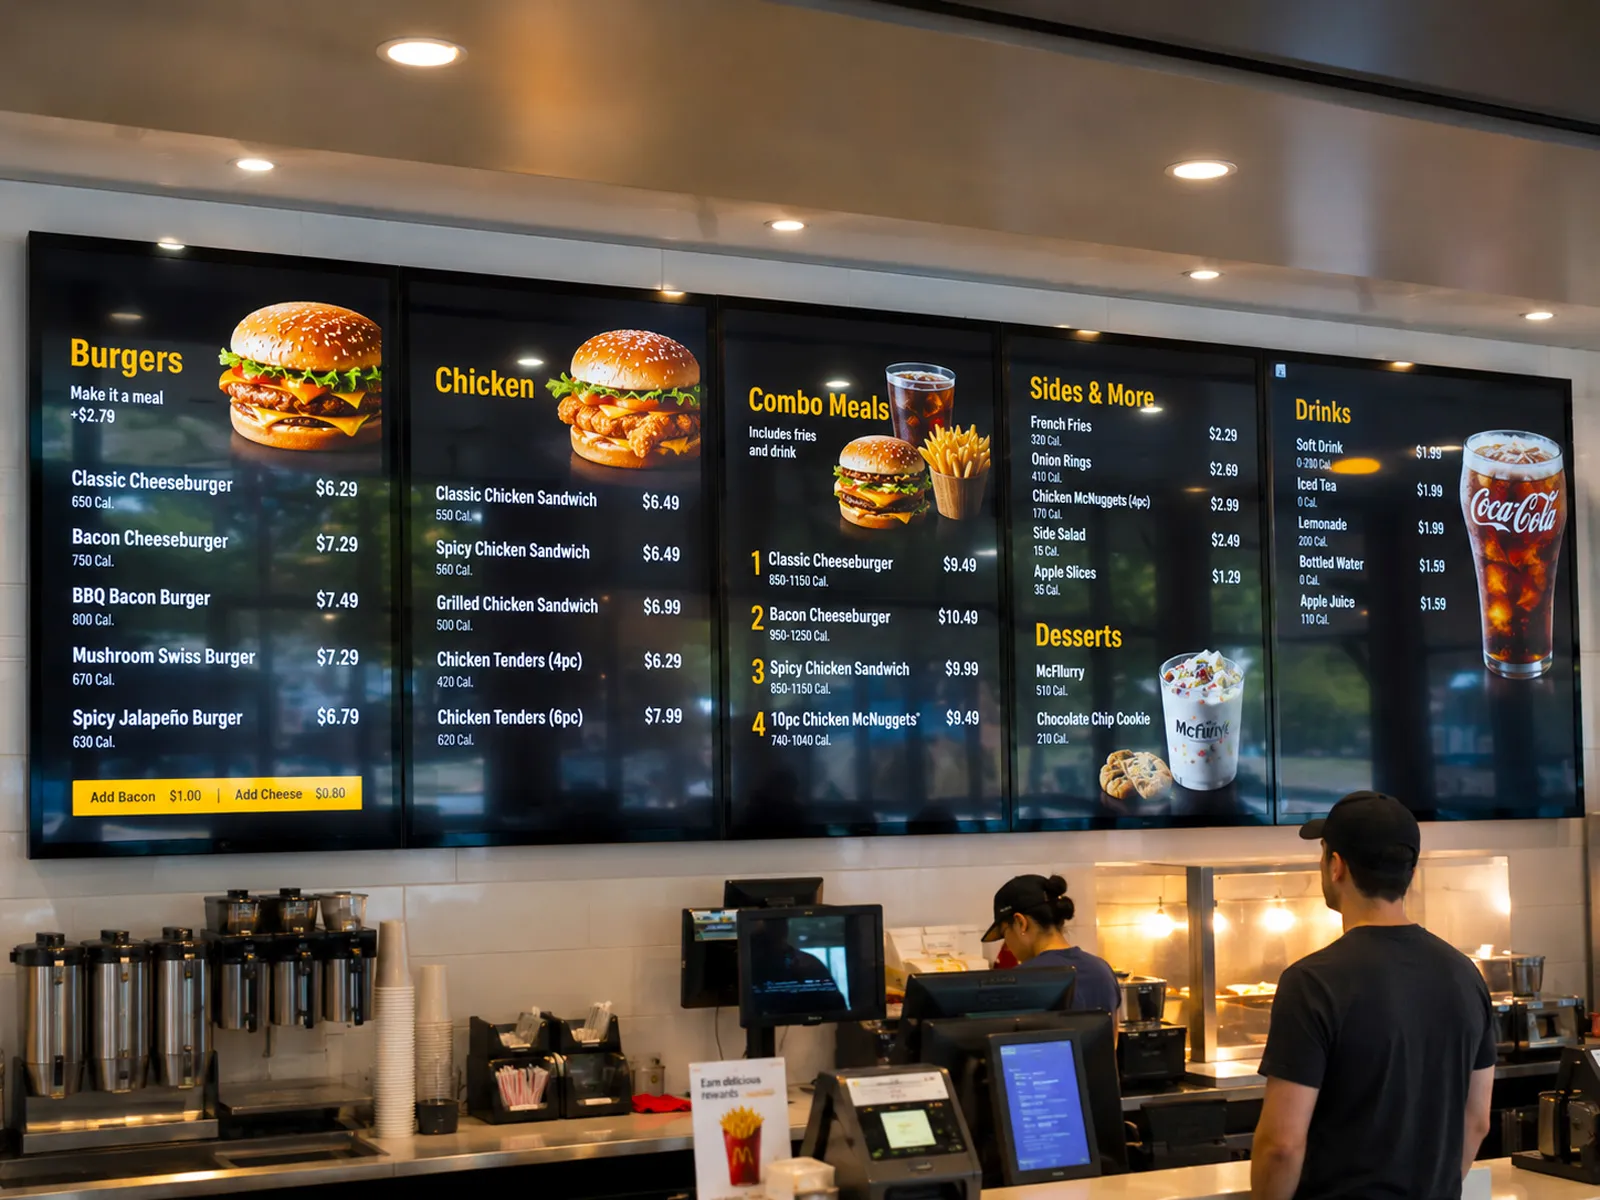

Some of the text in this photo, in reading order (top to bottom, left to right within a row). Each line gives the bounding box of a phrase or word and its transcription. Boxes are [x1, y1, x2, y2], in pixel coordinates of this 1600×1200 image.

[70, 338, 183, 378] Burgers
[436, 367, 534, 398] Chicken
[70, 386, 163, 405] Make it a meal
[1030, 376, 1154, 408] Sides & More
[749, 387, 889, 420] Combo Meals
[70, 408, 115, 423] +$2.79
[1296, 399, 1351, 424] Drinks
[1031, 416, 1092, 432] French Fries
[749, 426, 817, 442] Includes fries
[1031, 434, 1045, 445] 320
[1209, 426, 1237, 442] $2.29
[749, 446, 796, 459] and drink
[1297, 438, 1343, 454] Soft Drink
[1416, 445, 1442, 460] $1.99
[1032, 452, 1092, 471] Onion Rings
[1032, 472, 1046, 482] 410
[1210, 462, 1238, 477] $2.69
[72, 471, 233, 494] Classic Cheeseburger
[316, 480, 358, 498] $6.29
[1297, 478, 1336, 492] Iced Tea
[436, 486, 597, 507] Classic Chicken Sandwich
[1417, 483, 1442, 498] $1.99
[72, 496, 114, 509] 650 Cal.
[643, 493, 679, 510] $6.49
[1032, 490, 1150, 510] Chicken McNuggets (4pc)
[1211, 497, 1239, 512] $2.99
[1298, 496, 1303, 506] 0
[436, 510, 452, 520] 550
[1033, 509, 1047, 519] 170
[1470, 488, 1559, 533] Coca-Cola
[1298, 517, 1347, 531] Lemonade
[1418, 522, 1444, 535] $1.99
[72, 529, 228, 551] Bacon Cheeseburger
[1033, 527, 1086, 541] Side Salad
[1212, 533, 1240, 547] $2.49
[1298, 536, 1311, 546] 200
[316, 536, 358, 552] $7.29
[436, 540, 590, 559] Spicy Chicken Sandwich
[72, 554, 114, 567] 750 Cal.
[643, 546, 680, 562] $6.49
[436, 564, 453, 575] 560
[751, 550, 893, 575] 1 Classic Cheeseburger
[943, 557, 976, 572] $9.49
[1300, 556, 1364, 571] Bottled Water
[1420, 559, 1445, 573] $1.59
[769, 575, 810, 586] 850-1150
[1034, 565, 1096, 581] Apple Slices
[1213, 569, 1241, 584] $1.29
[1300, 575, 1305, 585] 0
[1034, 585, 1045, 595] 35
[72, 588, 210, 609] BBQ Bacon Burger
[316, 592, 358, 609] $7.49
[437, 595, 598, 614] Grilled Chicken Sandwich
[1300, 594, 1355, 610] Apple Juice
[1420, 597, 1446, 611] $1.59
[644, 599, 680, 615] $6.99
[72, 614, 114, 626] 800 Cal.
[751, 605, 890, 630] 2 Bacon Cheeseburger
[938, 609, 978, 625] $10.49
[1301, 614, 1313, 624] 110
[437, 620, 453, 630] 500
[770, 630, 812, 641] 950-1250
[1036, 623, 1122, 648] Desserts
[73, 648, 255, 668] Mushroom Swiss Burger
[317, 649, 358, 666] $7.29
[437, 652, 582, 671] Chicken Tenders (4pc)
[644, 652, 682, 669] $6.29
[751, 658, 909, 684] 3 Spicy Chicken Sandwich
[946, 661, 978, 677] $9.99
[72, 674, 114, 686] 670 Cal.
[437, 676, 454, 687] 420
[770, 684, 813, 694] 850-1150
[1037, 685, 1051, 696] 510
[72, 709, 242, 730] Spicy Jalapeño Burger
[317, 708, 359, 726] $6.79
[438, 708, 583, 727] Chicken Tenders (6pc)
[645, 708, 682, 724] $7.99
[752, 711, 765, 736] 4
[771, 713, 800, 729] 10pc
[802, 713, 849, 727] Chicken
[947, 710, 979, 726] $9.49
[1037, 712, 1150, 728] Chocolate Chip Cookie
[73, 736, 115, 748] 630 Cal.
[438, 734, 474, 746] 620 Cal.
[772, 735, 813, 746] 740-1040
[1037, 733, 1052, 744] 210
[91, 789, 201, 803] Add Bacon $1.00
[235, 787, 346, 800] Add Cheese $0.80
[701, 1076, 761, 1087] Earn delicious
[701, 1089, 738, 1099] rewards
